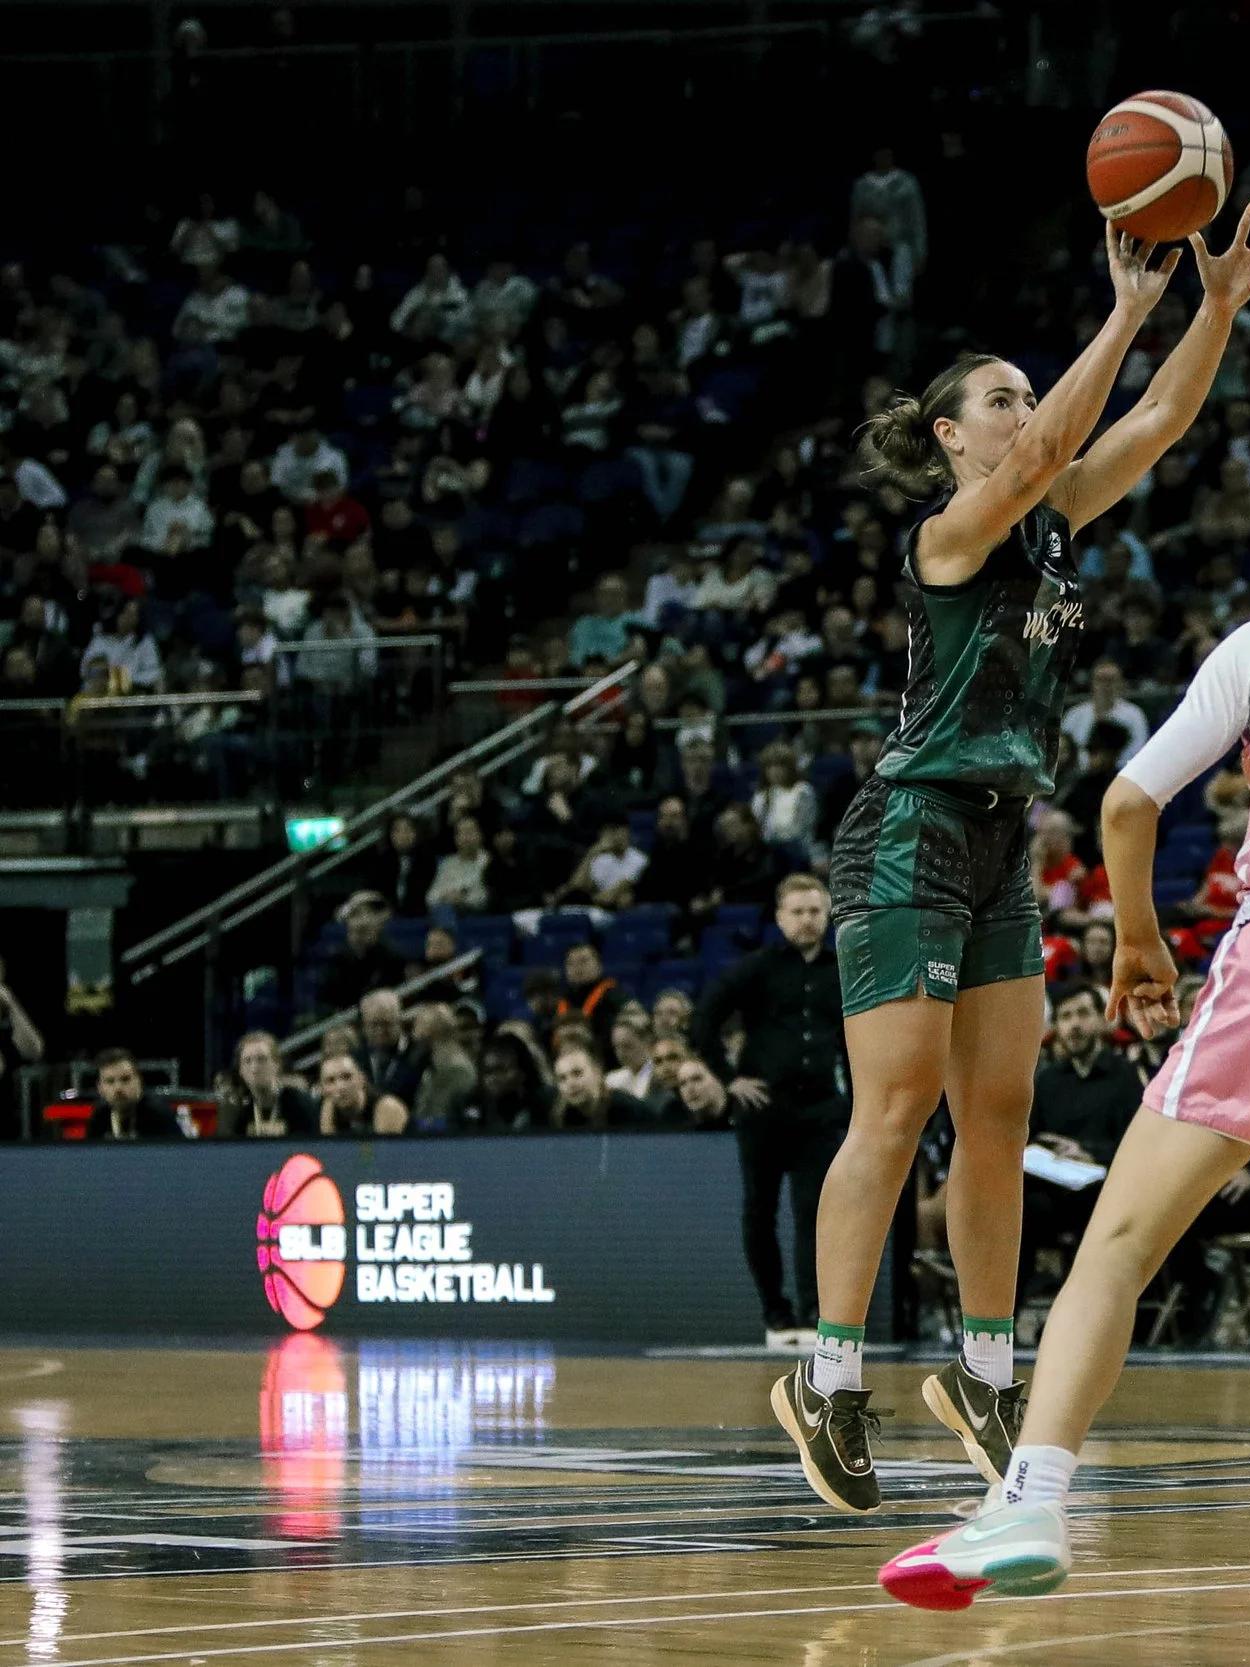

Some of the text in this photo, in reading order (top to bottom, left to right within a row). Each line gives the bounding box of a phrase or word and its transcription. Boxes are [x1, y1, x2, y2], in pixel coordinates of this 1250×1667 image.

[928, 961, 955, 971] SUPER
[928, 967, 957, 979] LEAGUE
[356, 1183, 454, 1221] SUPER
[279, 1224, 347, 1261] SLB
[356, 1223, 473, 1262] LEAGUE
[357, 1263, 555, 1302] BASKETBALL
